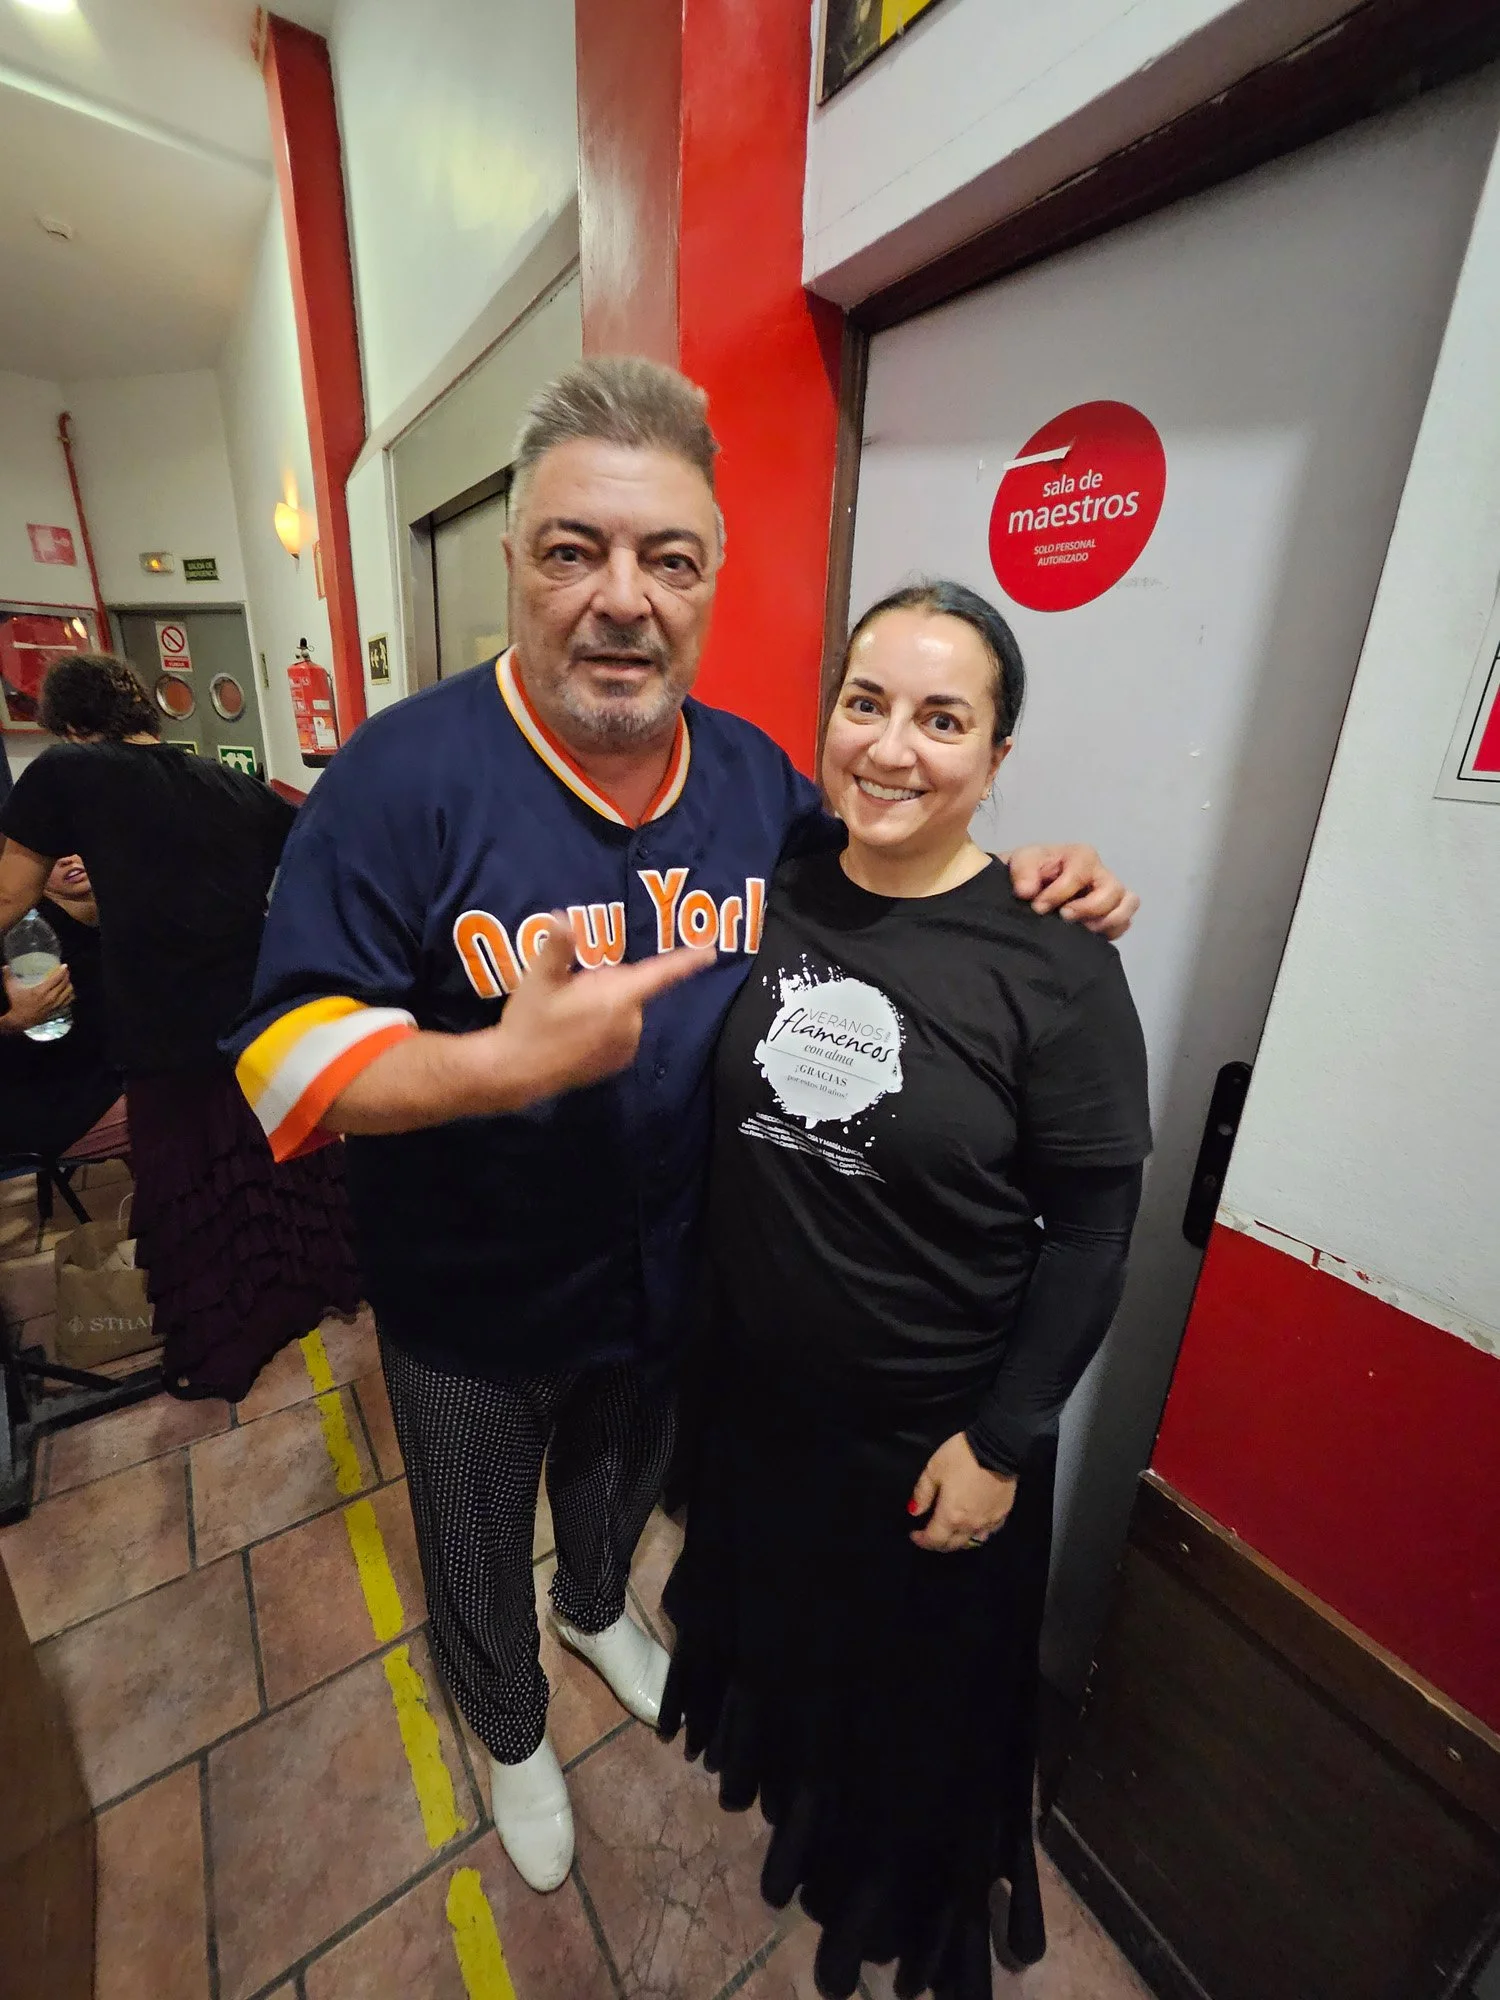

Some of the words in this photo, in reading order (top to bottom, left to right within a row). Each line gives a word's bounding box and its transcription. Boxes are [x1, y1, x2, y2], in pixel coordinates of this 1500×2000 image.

[1043, 474, 1074, 498] sala
[1079, 469, 1103, 491] de
[1008, 491, 1140, 535] maestros
[1034, 544, 1055, 555] SOLO
[1055, 539, 1096, 552] PERSONAL
[1037, 552, 1089, 567] AUTORIZADO
[770, 1008, 895, 1063] flamencos
[809, 1008, 884, 1042] VERANOS
[804, 1043, 824, 1057] con
[825, 1049, 854, 1066] alma
